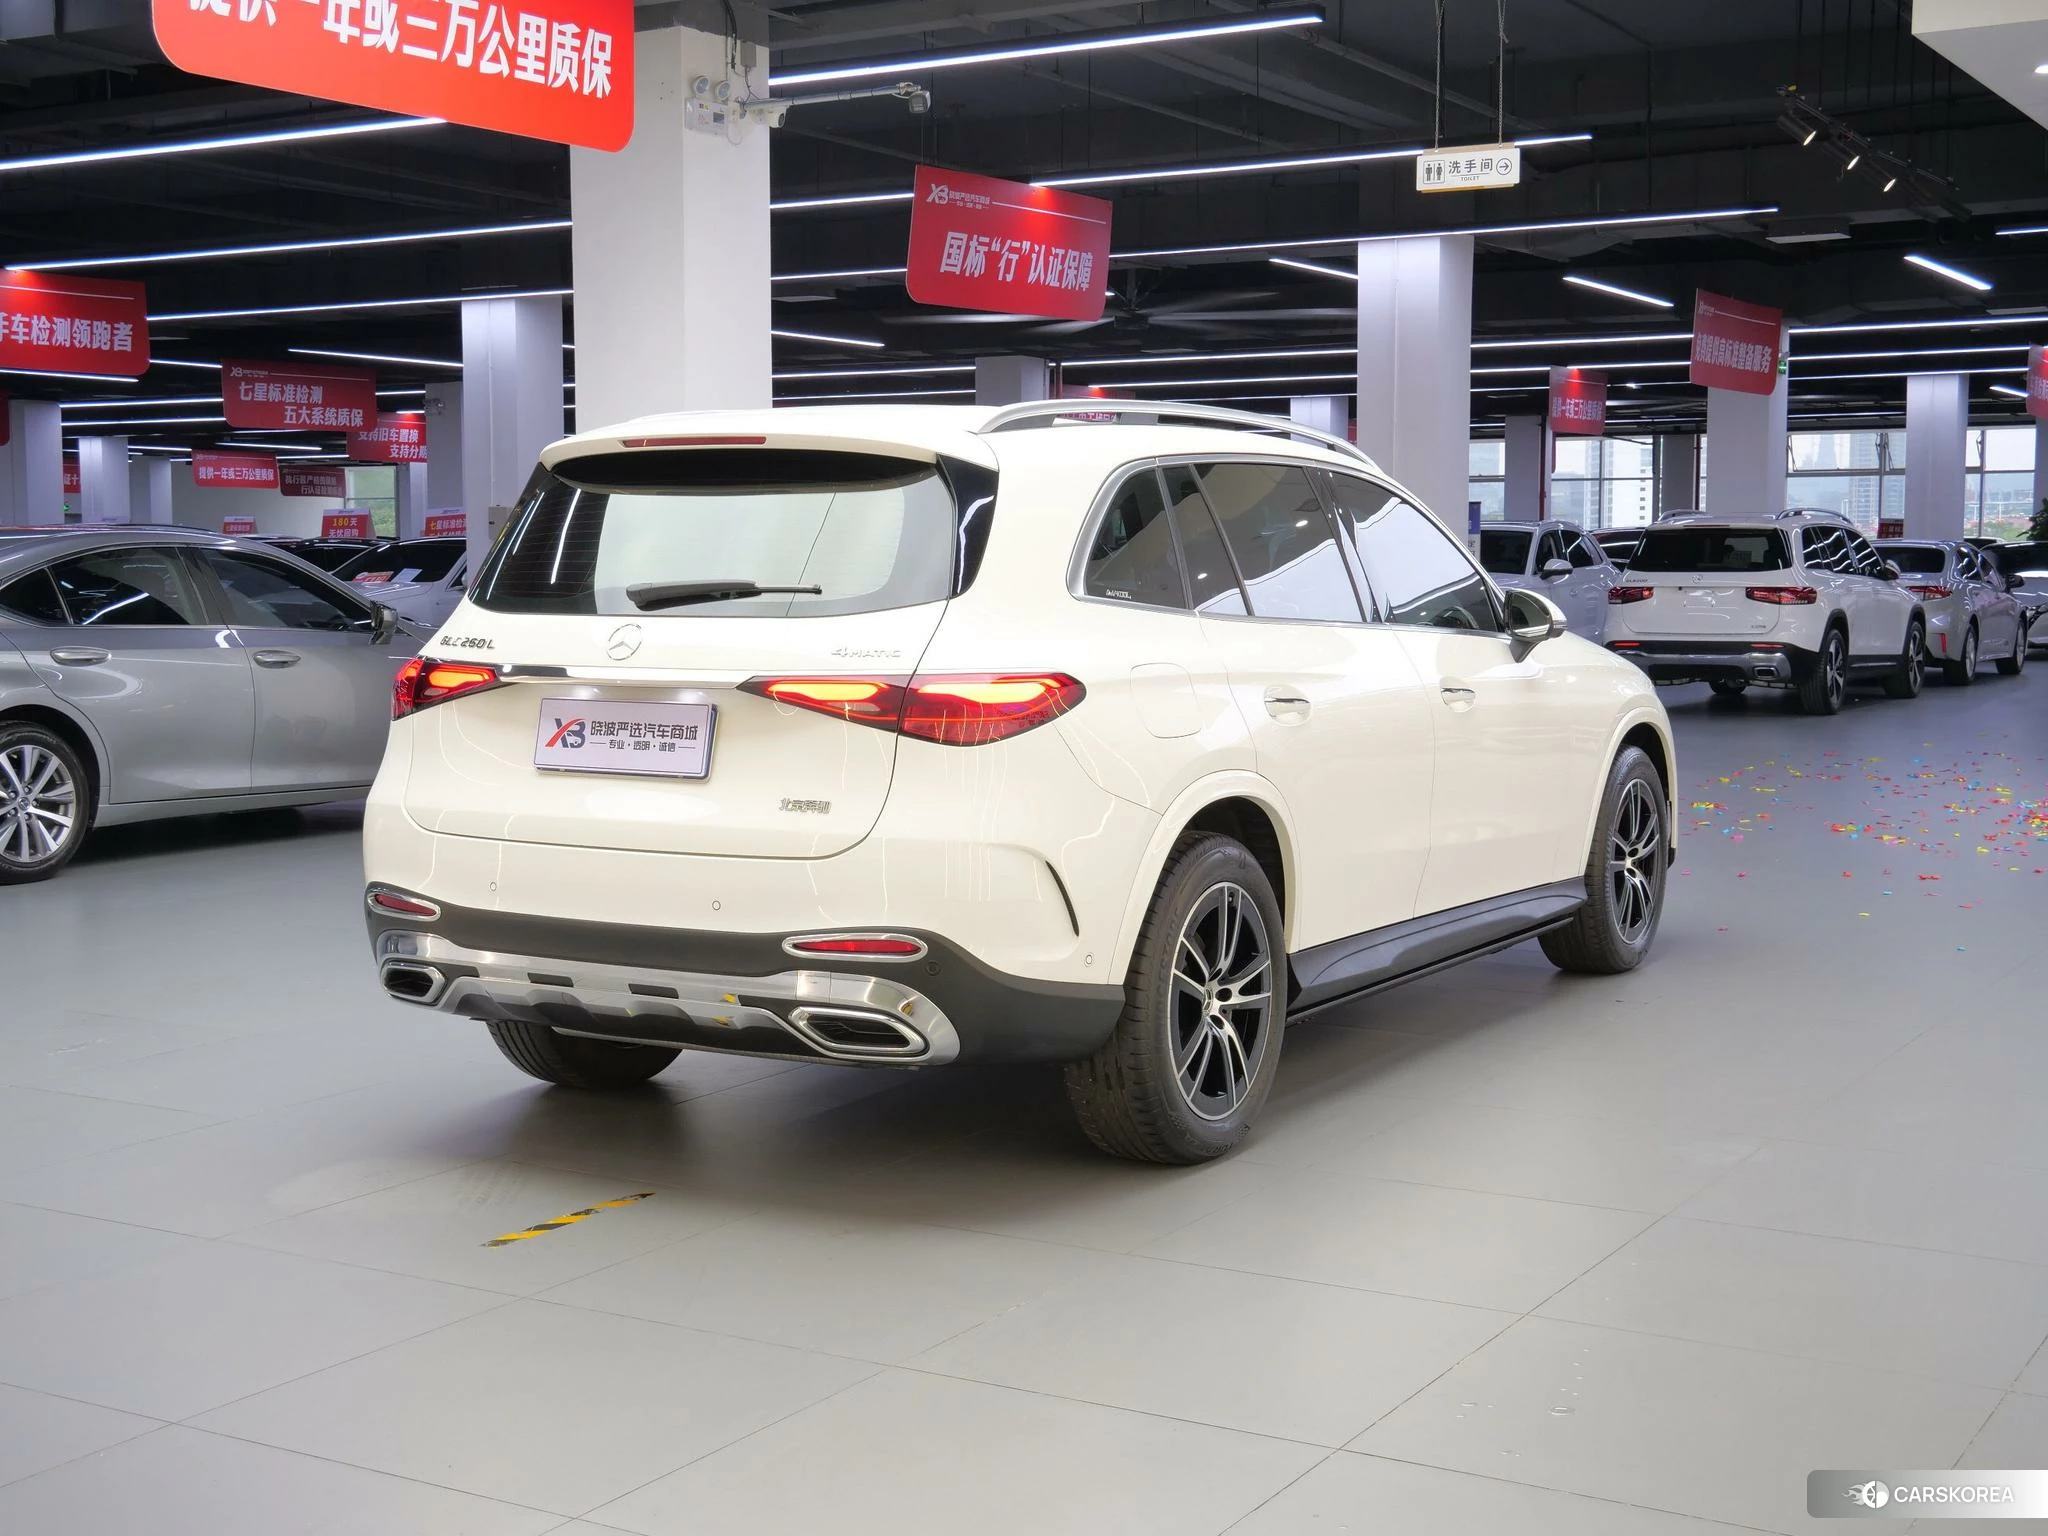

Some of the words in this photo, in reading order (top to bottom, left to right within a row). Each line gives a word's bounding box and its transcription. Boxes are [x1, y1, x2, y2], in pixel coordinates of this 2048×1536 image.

[188, 0, 613, 98] 年或三万公里质保
[1448, 158, 1493, 174] 洗手间
[939, 231, 1093, 291] 国标“行”认证保障
[239, 382, 323, 404] 七星标准检测
[283, 405, 364, 427] 五大系统质保
[332, 517, 349, 526] 180
[350, 518, 358, 526] 天
[460, 637, 487, 649] 260
[831, 646, 901, 658] 4MATIC
[590, 720, 698, 741] 晓波严选汽车商城
[779, 798, 831, 814] 北京奔驰
